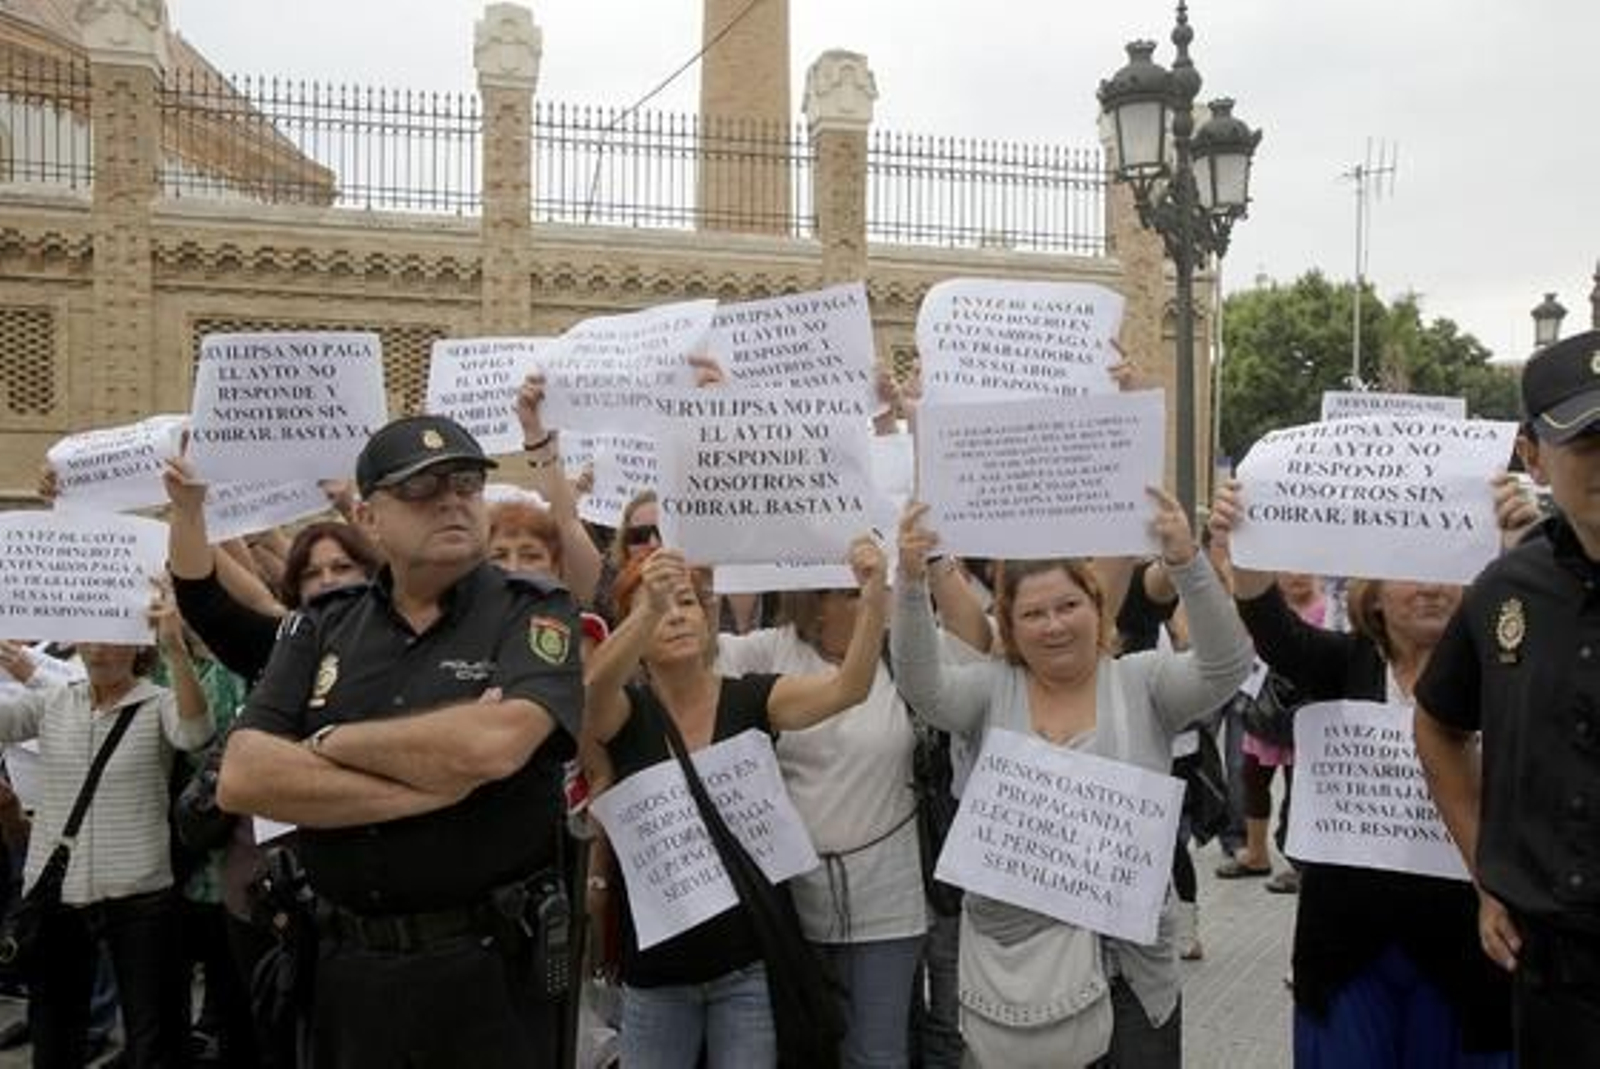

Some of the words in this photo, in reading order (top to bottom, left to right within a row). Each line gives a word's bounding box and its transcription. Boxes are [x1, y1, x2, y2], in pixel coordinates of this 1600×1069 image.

[786, 301, 809, 314] NO
[809, 295, 857, 313] PAGA
[754, 325, 797, 342] AYTO
[803, 320, 827, 332] NO
[290, 343, 317, 357] NO
[322, 343, 372, 357] PAGA
[732, 341, 809, 363] RESPONDE
[820, 338, 829, 349] Y
[218, 365, 242, 380] EL
[248, 365, 300, 380] AYTO
[309, 364, 337, 379] NO
[731, 360, 814, 379] NOSOTROS
[817, 355, 843, 368] SIN
[790, 372, 840, 388] BASTA
[844, 370, 868, 383] YA
[218, 386, 316, 402] RESPONDE
[326, 384, 338, 399] Y
[213, 406, 313, 421] NOSOTROS
[318, 404, 349, 418] SIN
[656, 399, 778, 417] SERVILIPSA
[784, 399, 811, 415] NO
[815, 399, 863, 415] PAGA
[280, 425, 341, 441] BASTA
[346, 424, 372, 438] YA
[700, 424, 727, 443] EL
[734, 424, 792, 442] AYTO
[802, 424, 829, 439] NO
[1392, 421, 1424, 438] NO
[1431, 423, 1498, 441] PAGA
[698, 449, 810, 468] RESPONDE
[819, 448, 832, 463] Y
[1295, 442, 1324, 455] EL
[1327, 443, 1394, 457] AYTO
[1408, 442, 1442, 457] NO
[1287, 461, 1410, 478] RESPONDE
[1424, 463, 1435, 478] Y
[688, 474, 805, 492] NOSOTROS
[810, 472, 839, 489] SIN
[1275, 481, 1400, 501] NOSOTROS
[1404, 485, 1446, 502] SIN
[766, 499, 832, 515] BASTA
[838, 496, 863, 512] YA
[1352, 507, 1431, 529] BASTA
[1439, 511, 1474, 531] YA
[0, 559, 88, 571] ENTENARIOS
[1343, 725, 1376, 738] VEZ
[1381, 729, 1405, 742] DE
[1324, 742, 1374, 757] TANTO
[1379, 746, 1417, 759] DIN
[734, 759, 757, 778] EN
[980, 754, 1051, 787] MENOS
[1056, 776, 1134, 811] GASTOS
[1138, 799, 1165, 818] EN
[996, 781, 1133, 837] PROPAGANDA
[1335, 801, 1364, 814] SUS
[970, 799, 1080, 845] ELECTORAL
[1099, 836, 1153, 868] PAGA
[1360, 821, 1451, 844] RESPONSA
[972, 825, 997, 845] AL
[1002, 832, 1101, 877] PERSONAL
[1111, 865, 1137, 886] DE
[982, 852, 1113, 905] SERVILIMPSA
